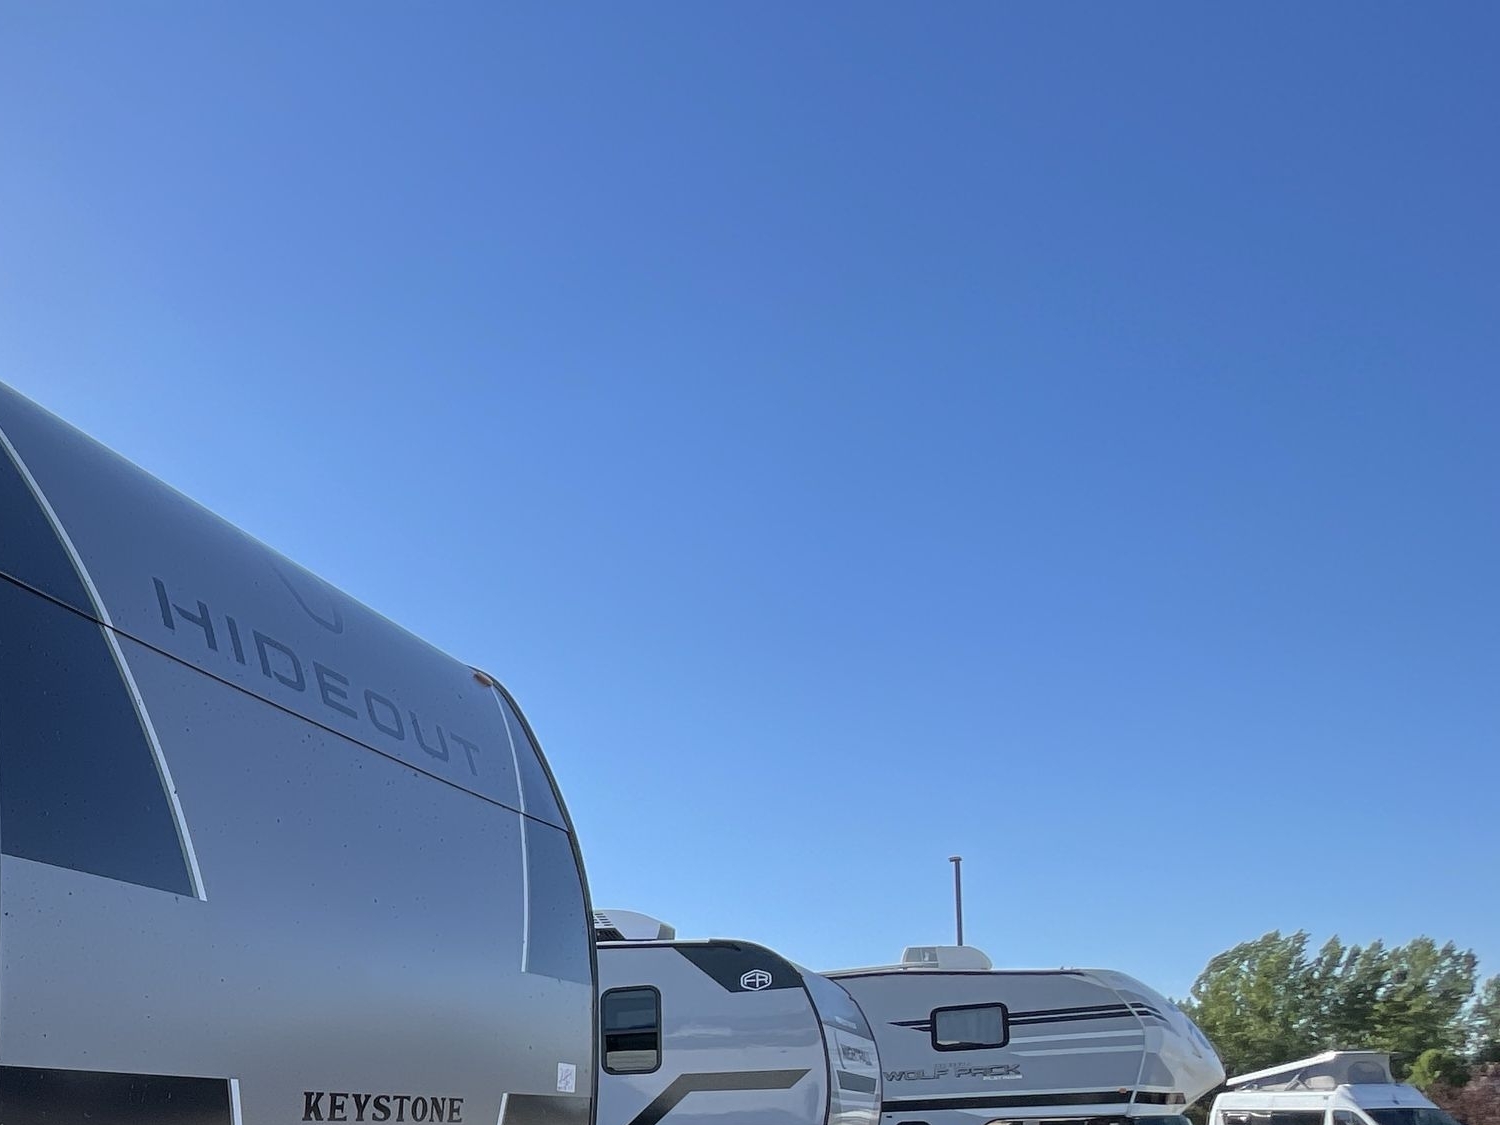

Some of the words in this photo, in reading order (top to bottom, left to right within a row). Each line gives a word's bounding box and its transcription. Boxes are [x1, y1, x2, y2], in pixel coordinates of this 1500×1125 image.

[152, 575, 479, 777] HIDEOUT
[883, 1067, 949, 1082] WOLF
[955, 1063, 1022, 1078] PACK
[302, 1091, 465, 1124] KEYSTONE
